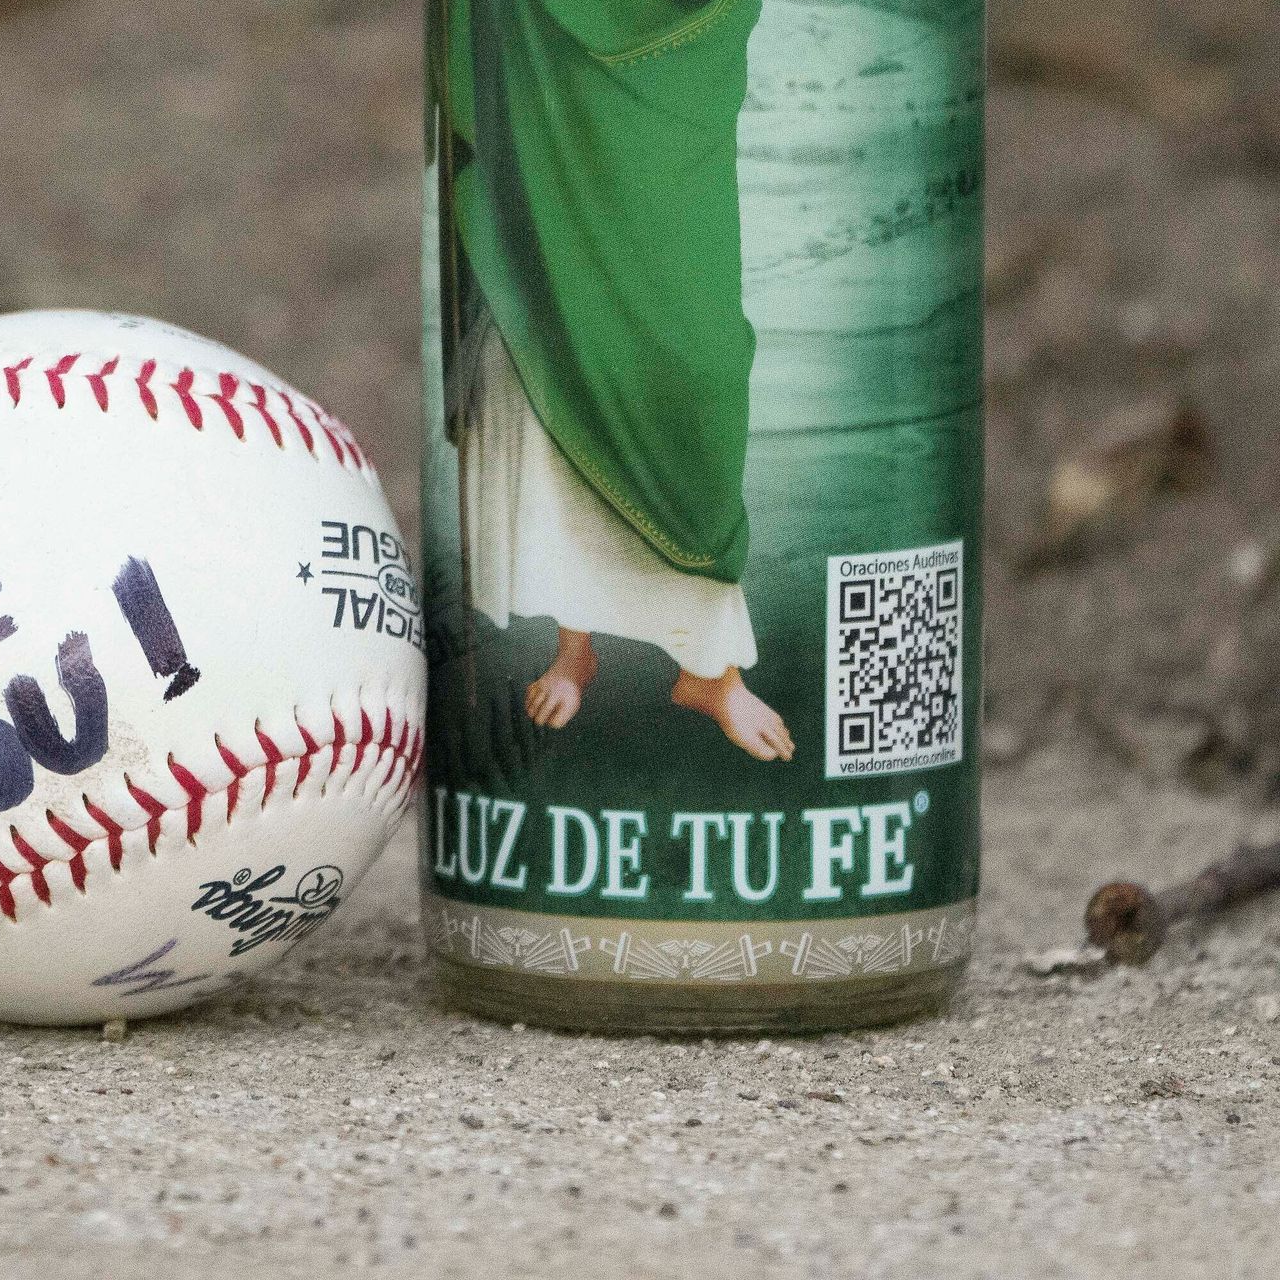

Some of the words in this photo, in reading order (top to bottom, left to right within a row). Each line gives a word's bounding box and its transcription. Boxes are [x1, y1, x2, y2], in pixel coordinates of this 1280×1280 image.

[322, 520, 411, 572] GUE
[840, 559, 909, 577] Oraciones
[913, 551, 959, 570] Auditivas
[322, 587, 425, 652] FICIAL
[840, 748, 956, 773] veladoramexico.online
[436, 788, 528, 890] LUZ
[546, 805, 649, 899] DE
[672, 812, 786, 902] TU
